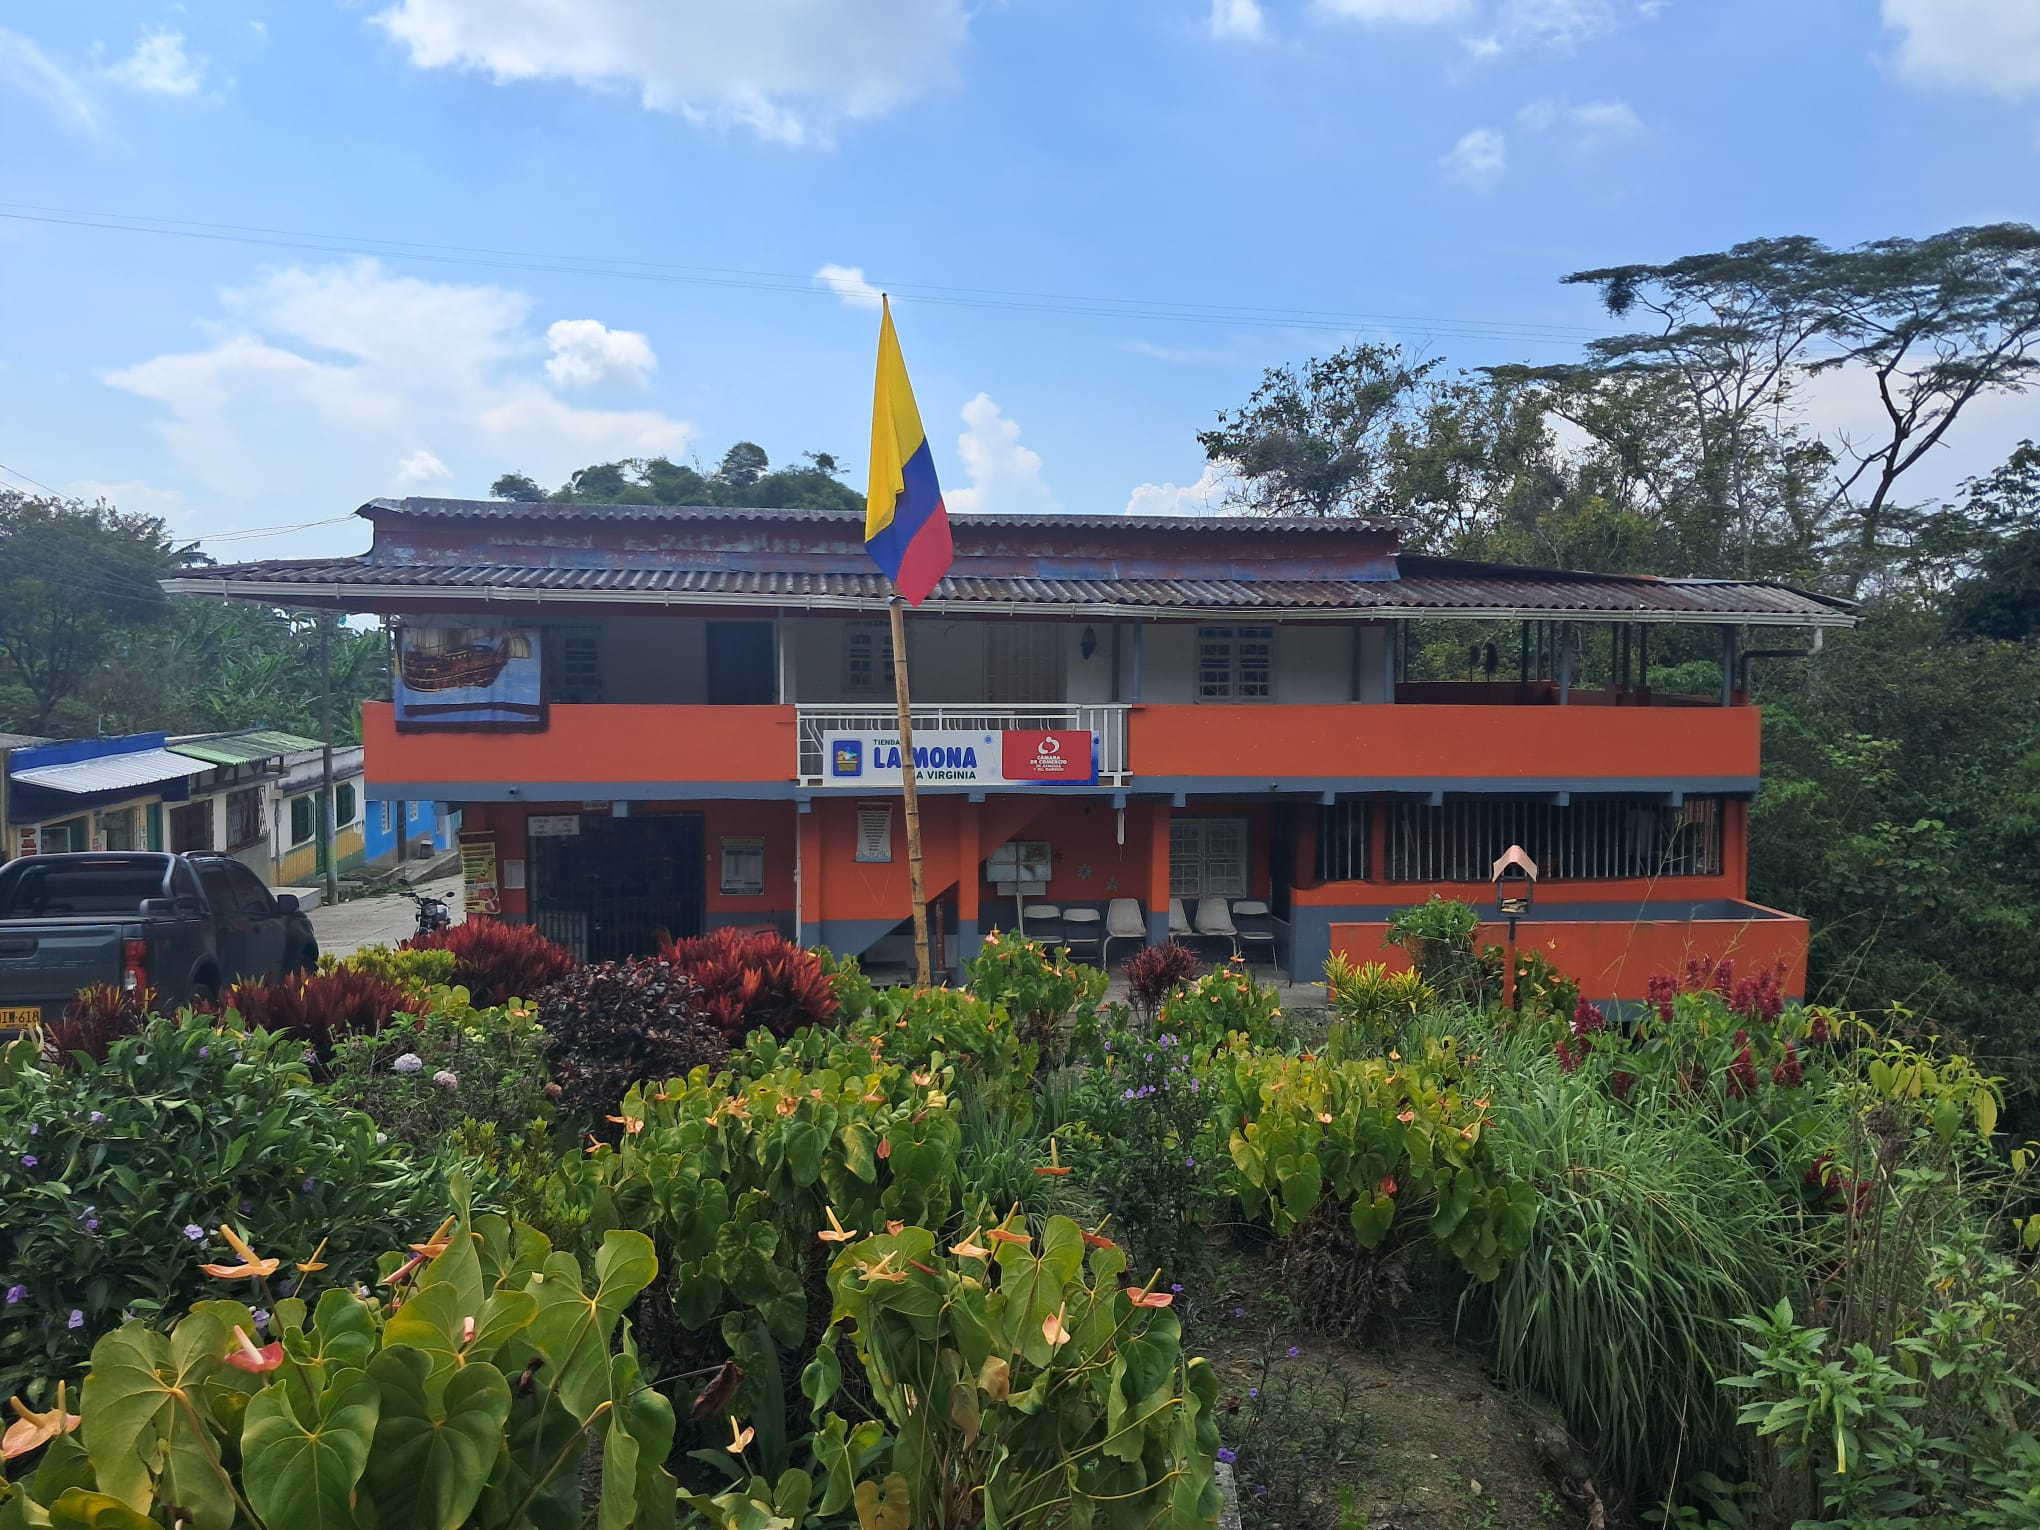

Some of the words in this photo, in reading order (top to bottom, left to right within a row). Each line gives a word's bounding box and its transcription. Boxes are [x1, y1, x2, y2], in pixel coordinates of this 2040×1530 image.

[874, 746, 901, 768] LA
[912, 746, 977, 768] MONA
[927, 771, 976, 779] VIRGINIA
